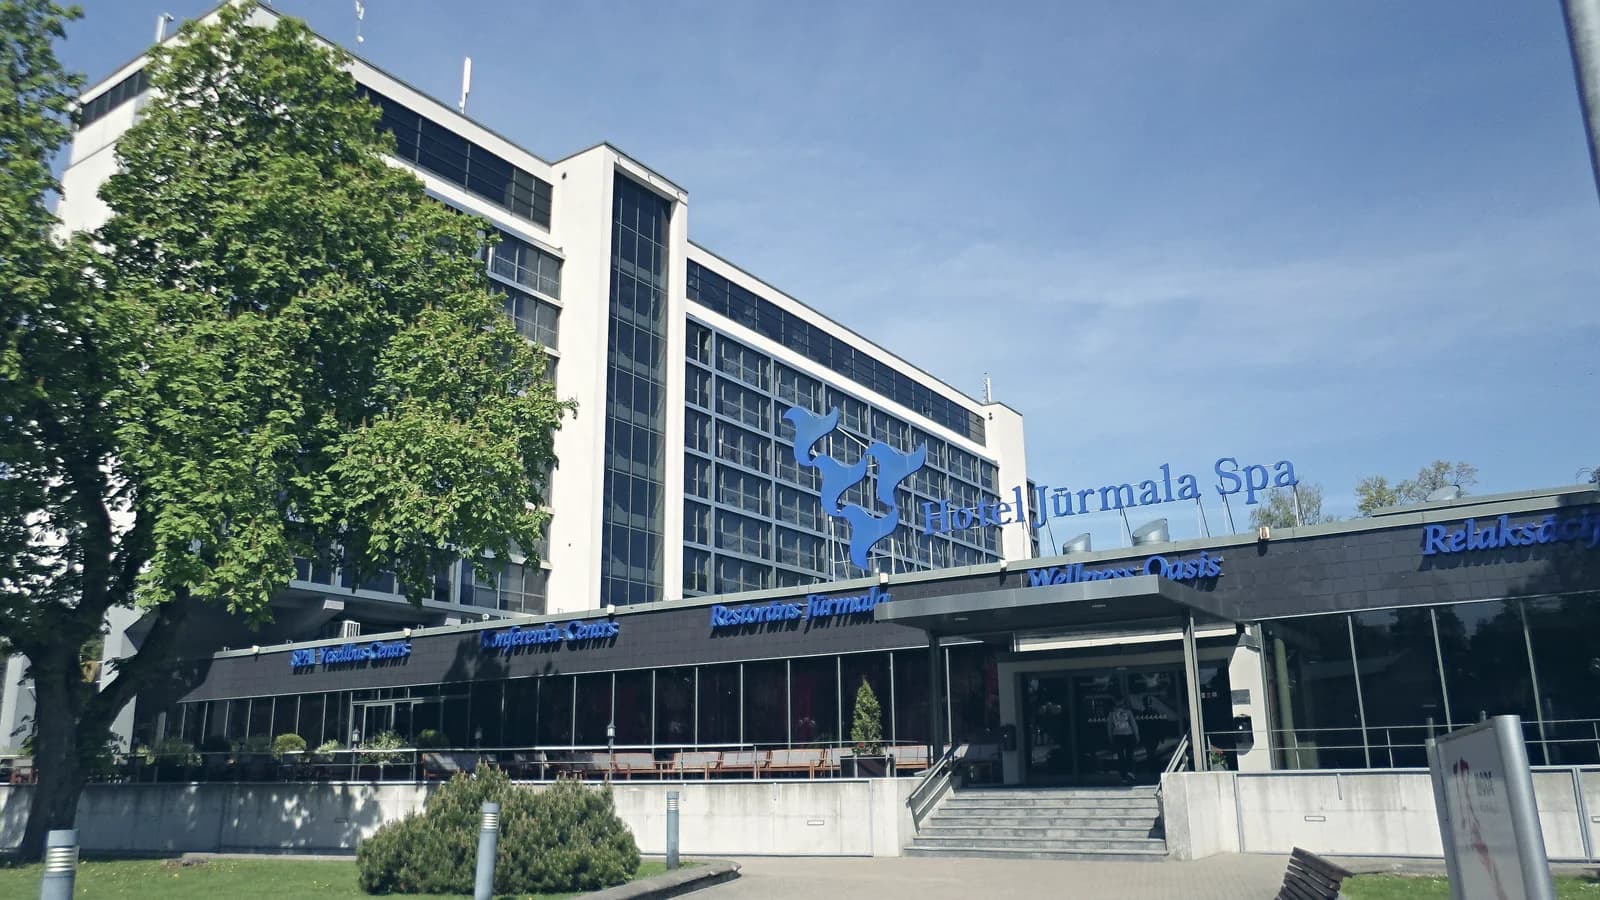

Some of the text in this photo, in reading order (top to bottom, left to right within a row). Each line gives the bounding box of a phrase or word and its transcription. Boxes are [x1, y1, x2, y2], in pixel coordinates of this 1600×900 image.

[922, 456, 1300, 536] Hotel Jūrmala Spa
[1142, 550, 1222, 581] Oasis
[564, 619, 620, 640] Centrs
[289, 648, 316, 667] SPA
